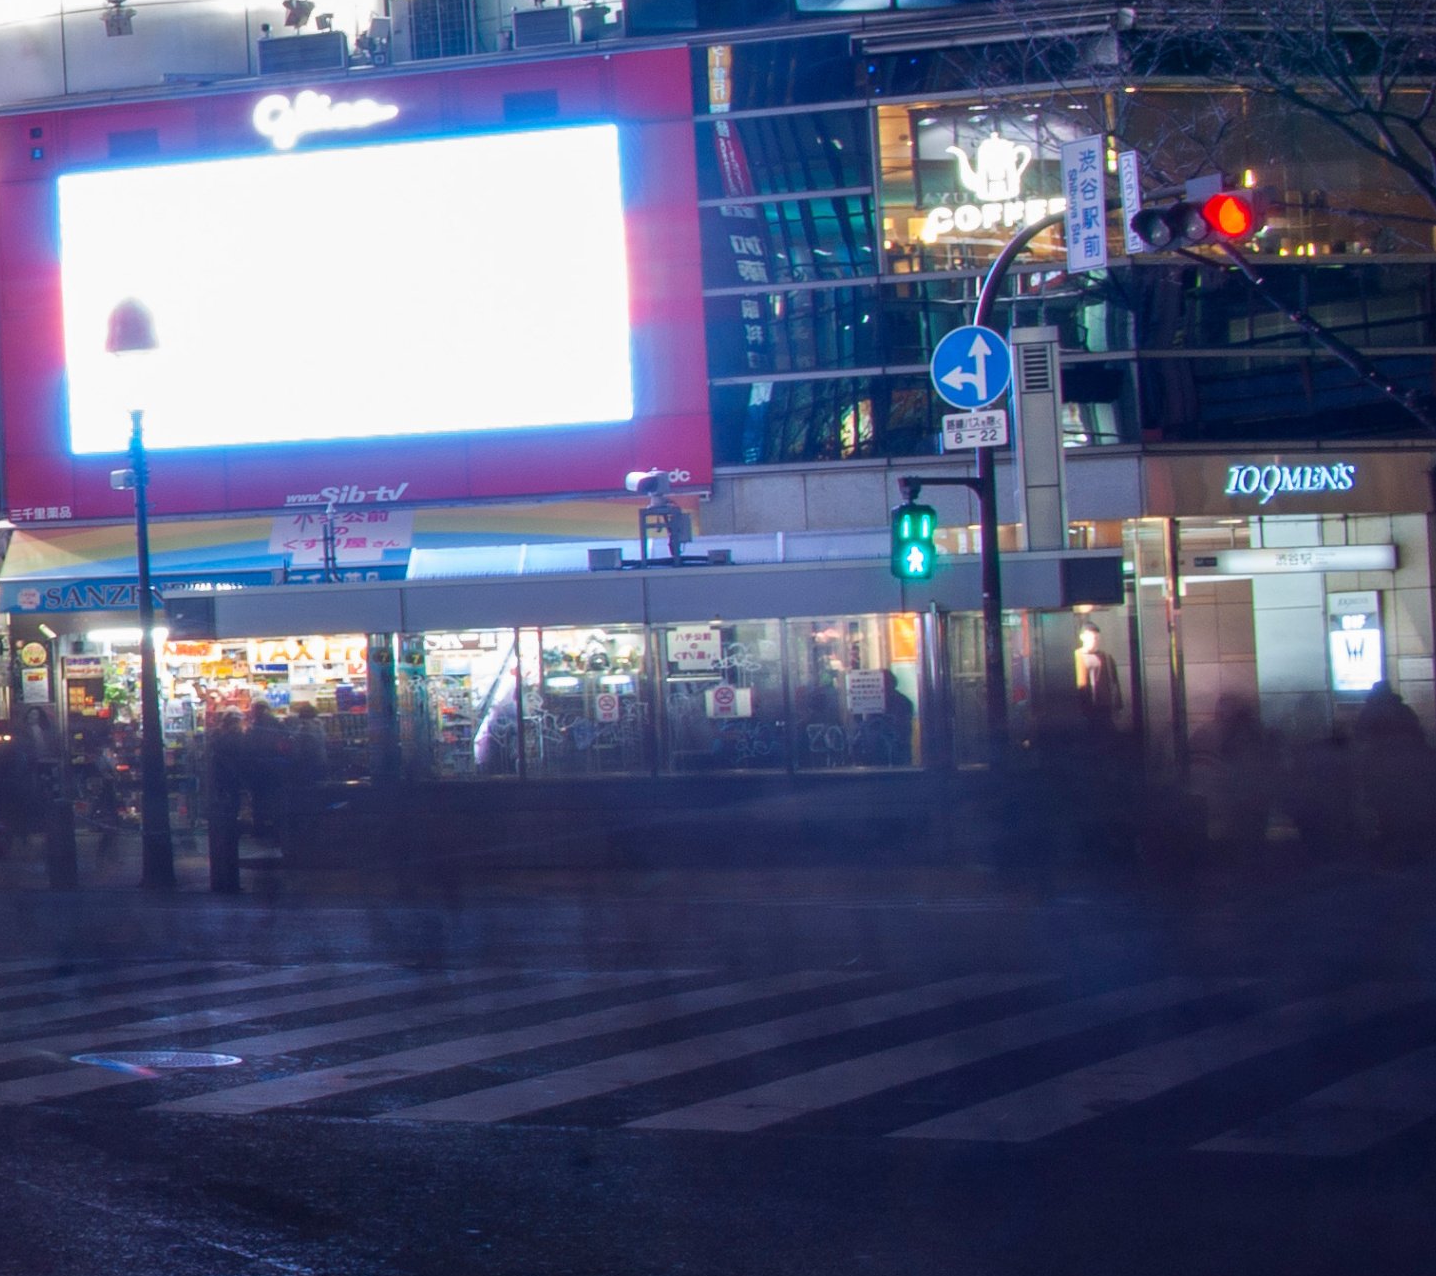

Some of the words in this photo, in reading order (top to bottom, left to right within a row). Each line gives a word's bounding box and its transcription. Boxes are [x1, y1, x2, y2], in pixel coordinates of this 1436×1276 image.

[1067, 169, 1081, 220] Shibuya
[1079, 149, 1100, 259] 渋谷駅前
[954, 432, 962, 444] 8
[980, 429, 997, 442] 22
[11, 507, 72, 521] 三千里薬品
[253, 640, 315, 662] TAX
